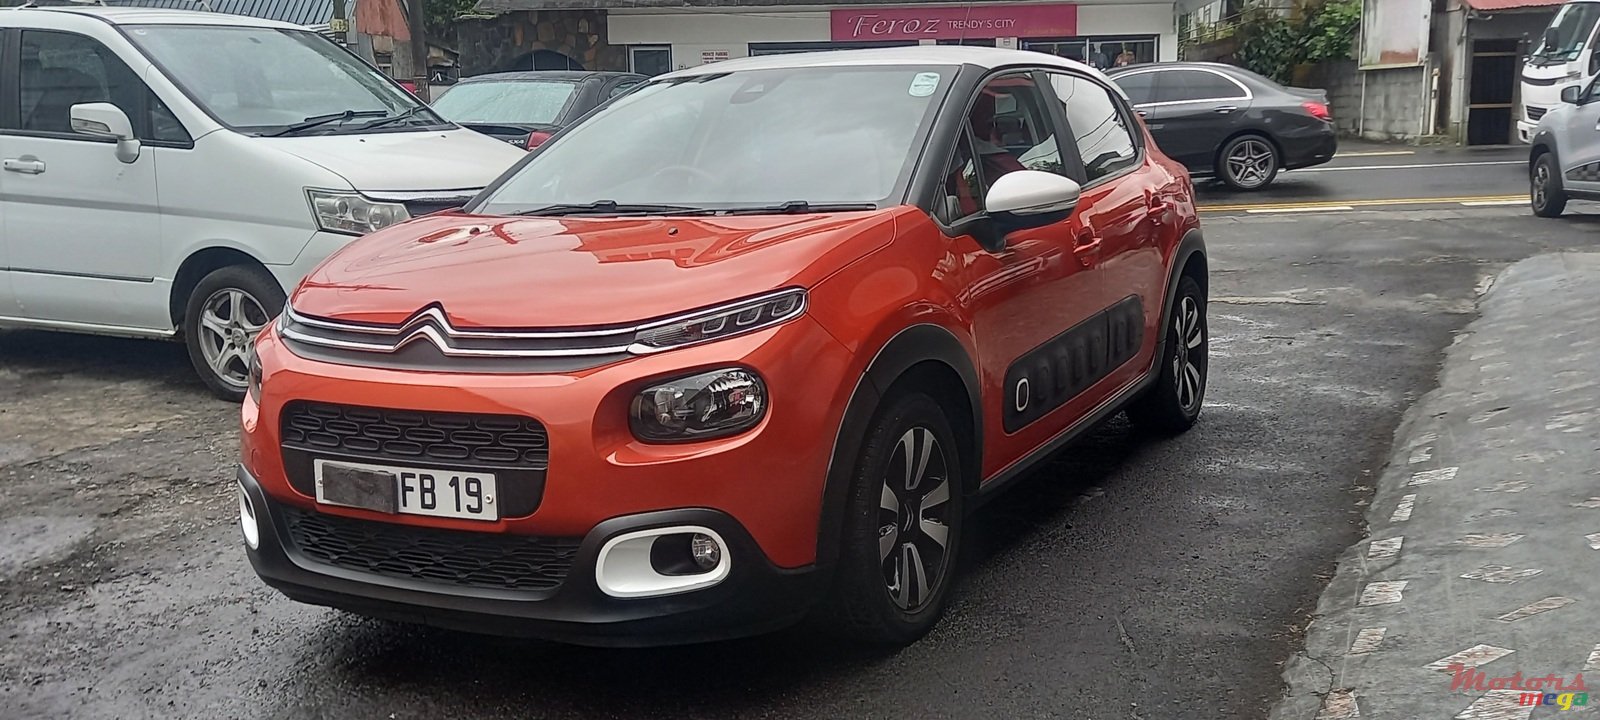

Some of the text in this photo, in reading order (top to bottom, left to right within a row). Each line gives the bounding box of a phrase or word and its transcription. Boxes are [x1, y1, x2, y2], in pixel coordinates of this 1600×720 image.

[848, 14, 1017, 38] Feroz TRENDY'S CITY
[400, 472, 483, 514] FB 19
